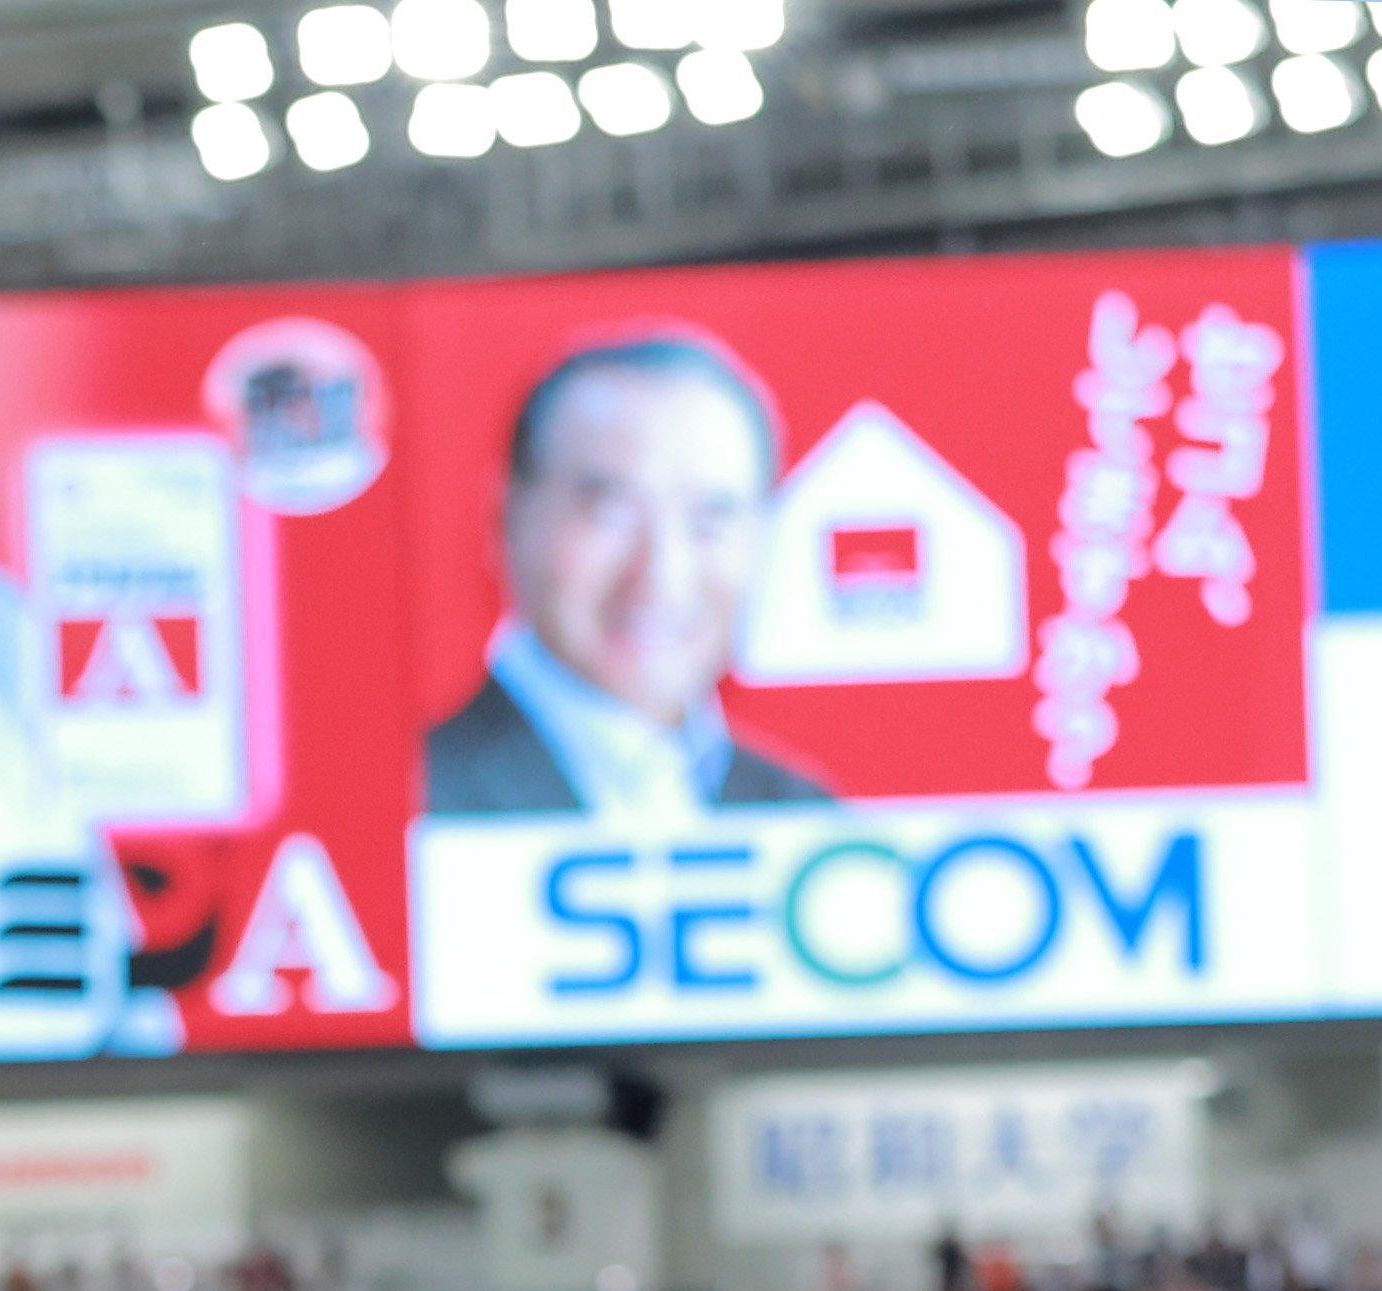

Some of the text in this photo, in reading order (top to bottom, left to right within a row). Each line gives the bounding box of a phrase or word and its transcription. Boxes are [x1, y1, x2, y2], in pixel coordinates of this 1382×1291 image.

[545, 835, 1209, 997] SECOM
[755, 1098, 1155, 1192] 昭和大学
